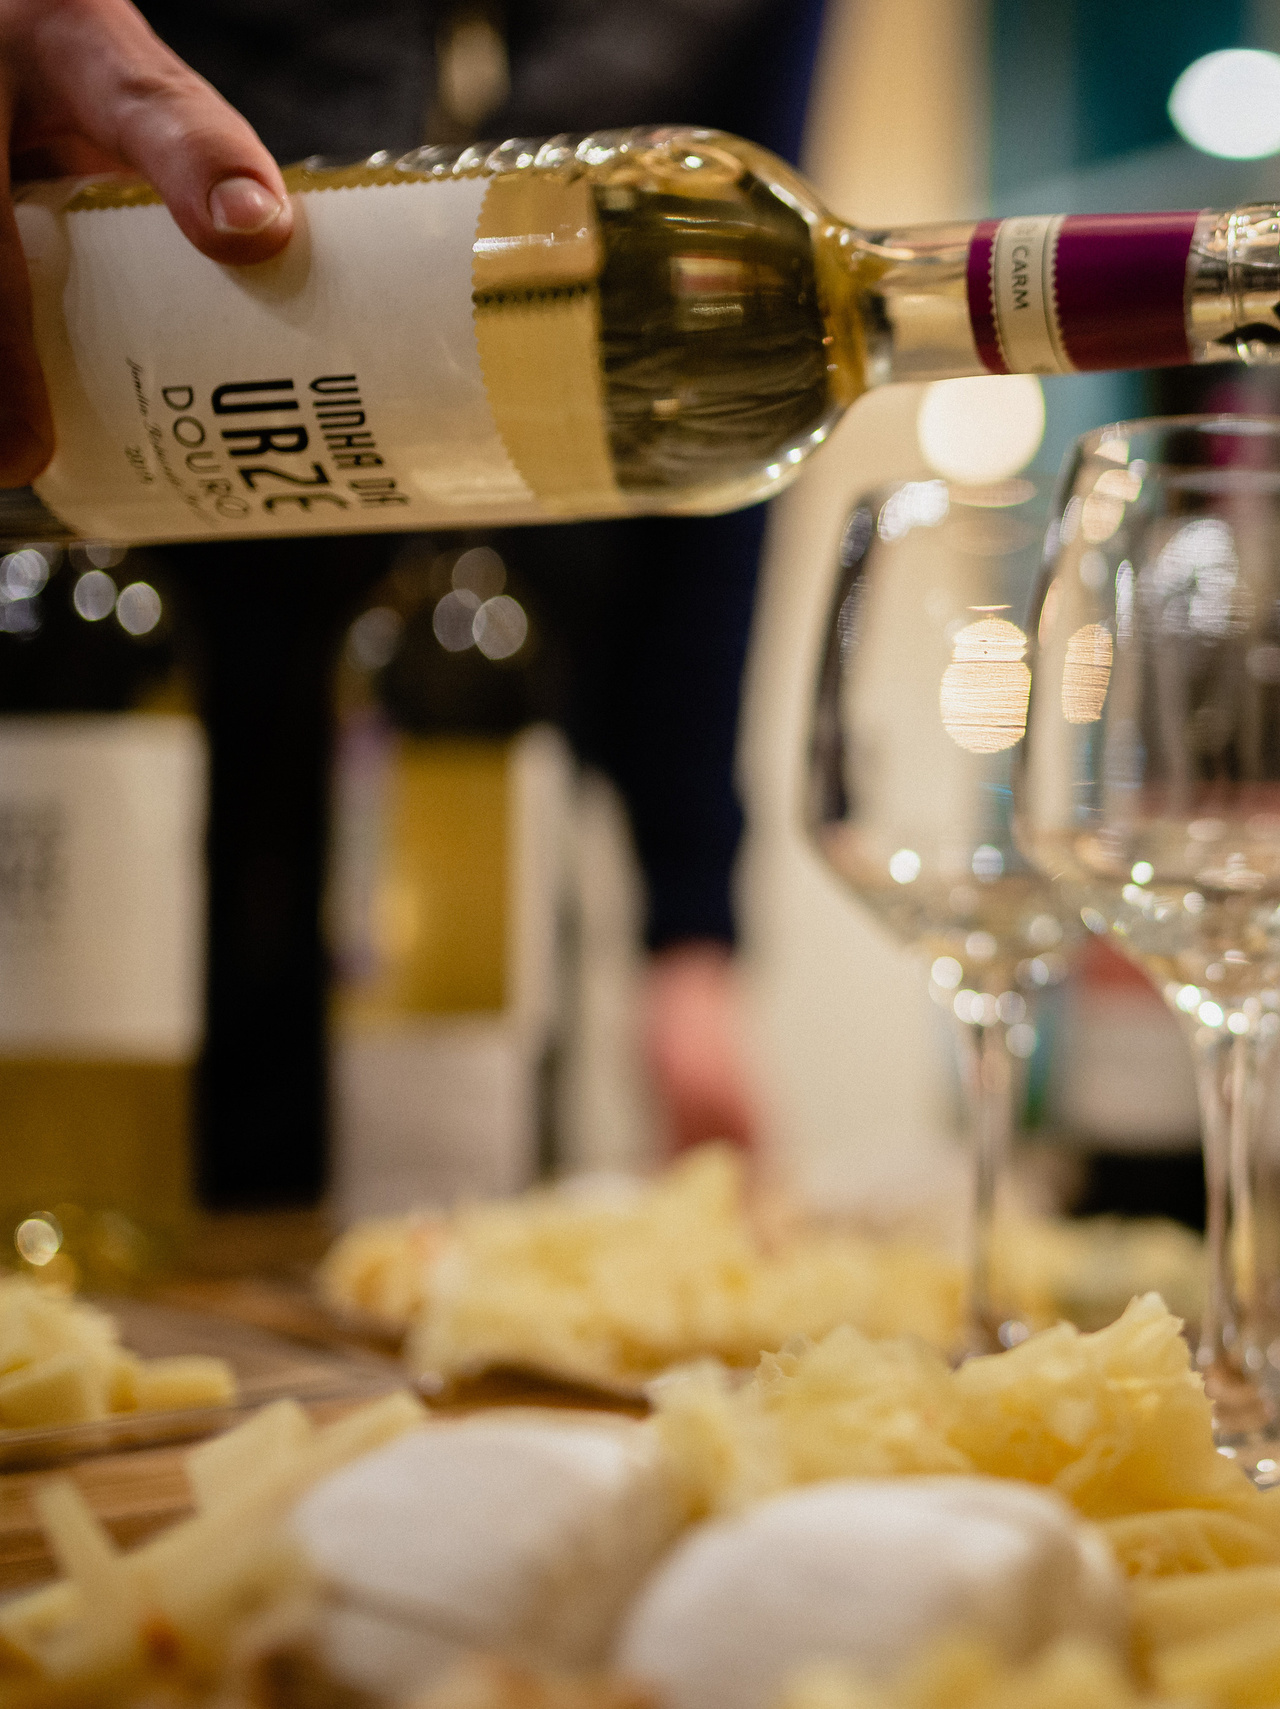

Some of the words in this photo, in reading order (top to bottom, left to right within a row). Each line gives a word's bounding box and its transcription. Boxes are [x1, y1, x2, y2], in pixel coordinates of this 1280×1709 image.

[1011, 245, 1030, 310] CARM
[161, 384, 251, 519] DOURO
[211, 379, 349, 515] URZE
[309, 373, 385, 469] VINHA
